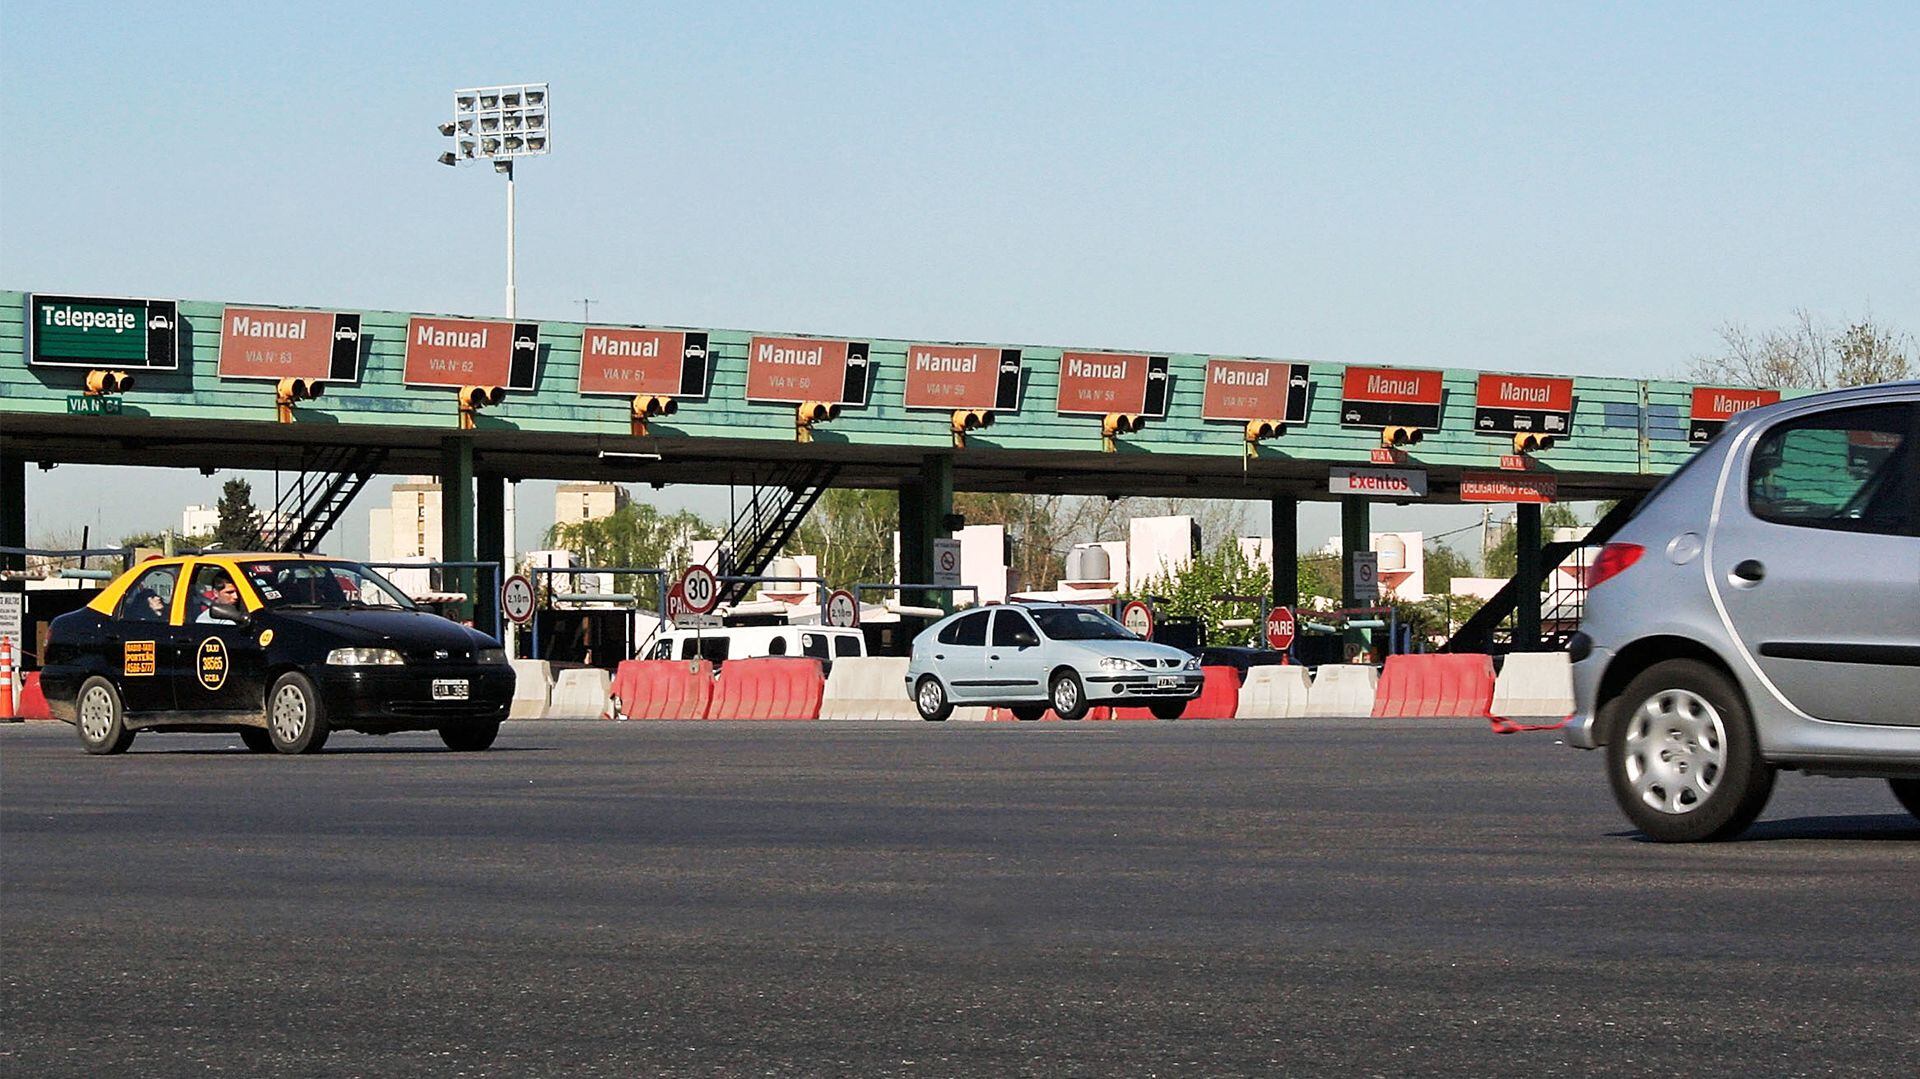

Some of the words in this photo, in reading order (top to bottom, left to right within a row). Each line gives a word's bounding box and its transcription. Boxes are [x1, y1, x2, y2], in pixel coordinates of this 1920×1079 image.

[42, 305, 136, 333] Telepeaje
[232, 316, 307, 340] Manual
[417, 325, 488, 349] Manual
[591, 335, 659, 357] Manual
[246, 350, 263, 362] VIA
[758, 344, 823, 366] Manual
[916, 352, 977, 373] Manual
[430, 359, 446, 371] VIA
[462, 361, 474, 372] 62
[603, 368, 619, 379] VIA
[1068, 358, 1127, 380] Manual
[769, 376, 785, 388] VIA
[1213, 366, 1270, 386] Manual
[927, 384, 940, 395] VIA
[1367, 375, 1420, 395] Manual
[1500, 382, 1550, 402] Manual
[1078, 389, 1092, 400] VIA
[70, 398, 88, 411] VIA
[1372, 450, 1386, 462] VIA
[1501, 457, 1514, 468] VIA
[1349, 472, 1408, 490] Exentos
[1463, 480, 1516, 494] OBLIGATORIO
[689, 578, 709, 600] 30
[1268, 620, 1293, 635] PARE
[205, 644, 220, 652] TAXI
